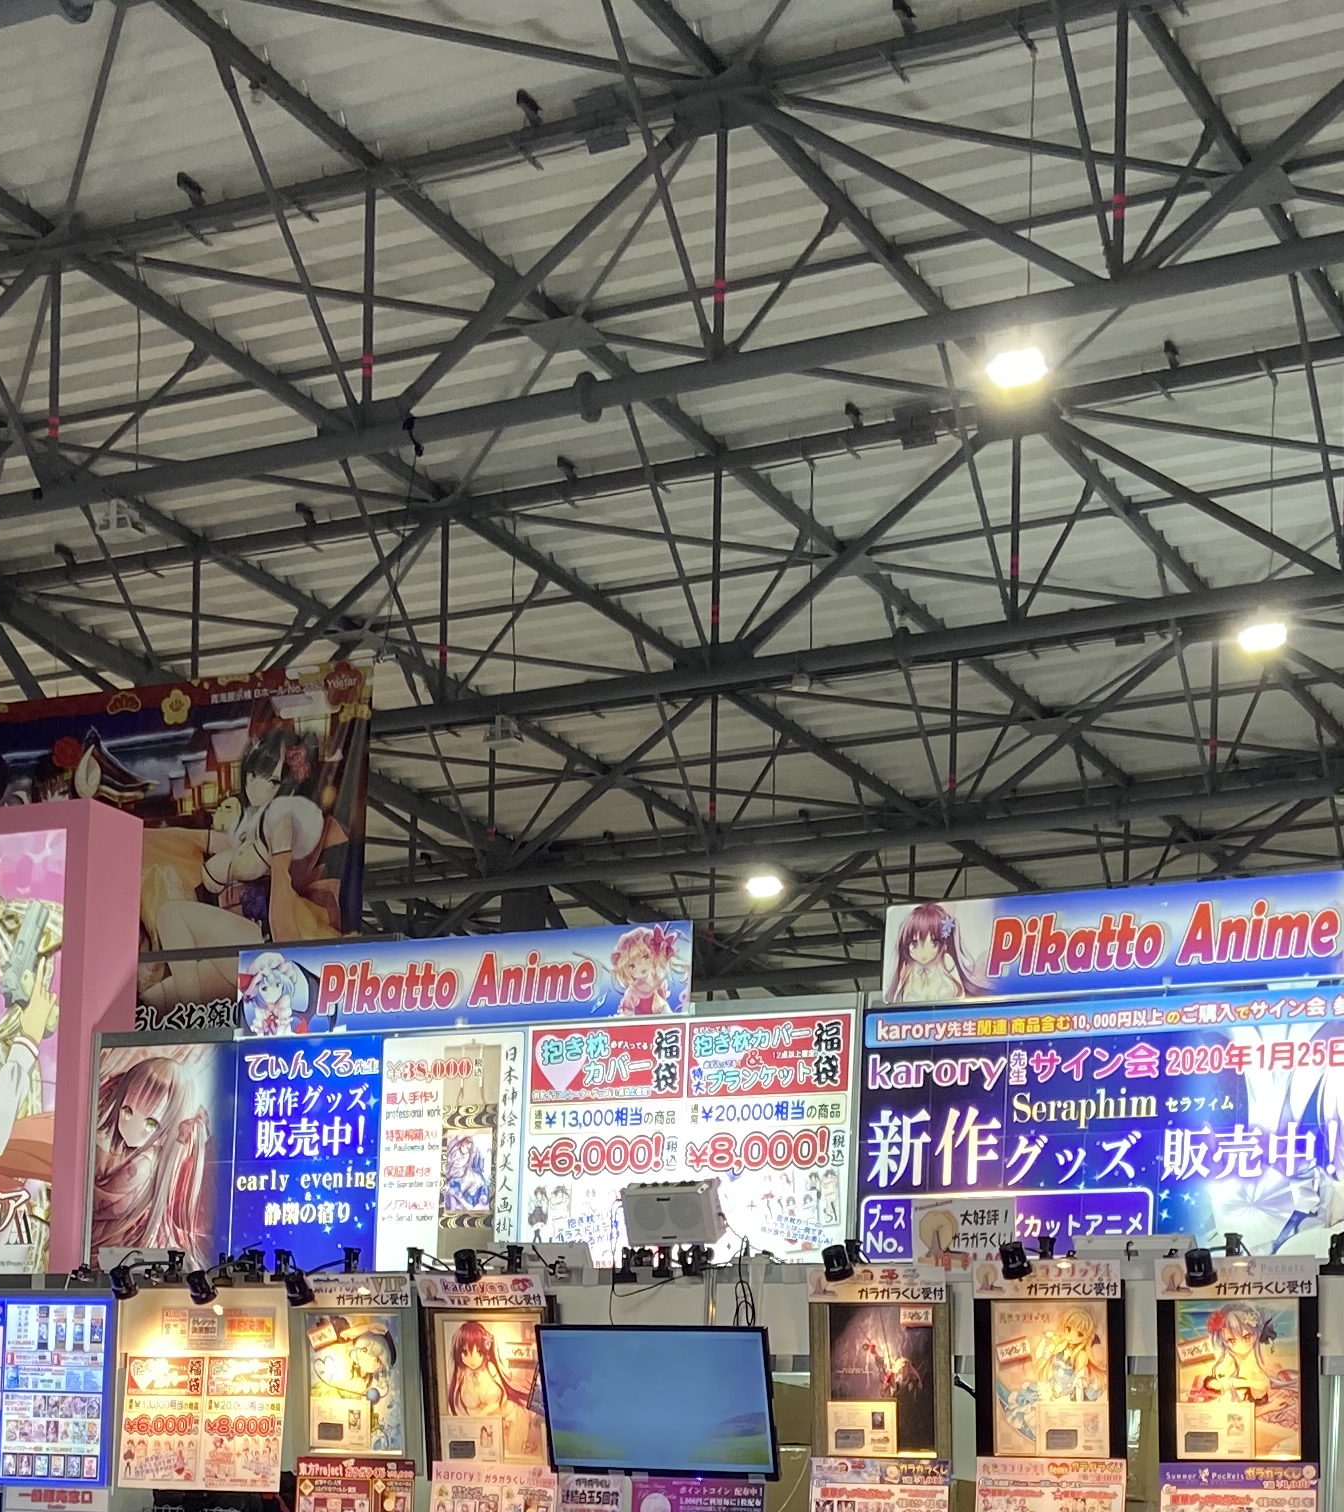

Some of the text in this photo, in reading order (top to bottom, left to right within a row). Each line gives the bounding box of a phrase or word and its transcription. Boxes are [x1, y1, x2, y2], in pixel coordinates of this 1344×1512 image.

[986, 898, 1341, 980] Pikatto Anime
[316, 950, 597, 1017] Pikatto Anime
[541, 1032, 611, 1066] 抱き枕
[693, 1027, 812, 1059] 抱き枕カバー
[746, 1049, 764, 1068] &
[814, 1021, 843, 1087] 福袋
[583, 1054, 653, 1086] カバー
[653, 1029, 682, 1094] 福袋
[707, 1061, 814, 1094] ブランケット
[868, 1053, 1008, 1091] karory
[1010, 1050, 1028, 1085] 先生
[1029, 1042, 1161, 1084] サイン会
[253, 1083, 370, 1118] 新作グッズ
[1012, 1088, 1235, 1130] Seraphim セラフィム
[255, 1115, 367, 1159] 販売中!
[495, 1046, 519, 1243] 日本神絵師美人画掛
[686, 1126, 830, 1178] ¥8,000!
[1159, 1119, 1338, 1182] 販売中!
[528, 1131, 664, 1180] ¥6,000!
[237, 1165, 377, 1193] early evening
[868, 1204, 906, 1230] ブース
[959, 1208, 1009, 1227] 大好評!
[866, 1231, 904, 1254] No.
[336, 1294, 409, 1306] ガラガラくじ受付
[371, 1276, 407, 1292] VIP
[474, 1293, 542, 1307] ガラガラくじ受付
[857, 1286, 945, 1301] ガラガラくじ受付
[1026, 1282, 1119, 1297] ガラガラくじ受付
[1215, 1279, 1313, 1296] ガラガラくじ受付
[124, 1413, 194, 1438] ¥6,000!
[205, 1415, 277, 1442] ¥8,000!
[435, 1469, 526, 1486] karory ガラガラくじ
[1165, 1471, 1197, 1481] Summer
[1211, 1471, 1245, 1481] Pockets
